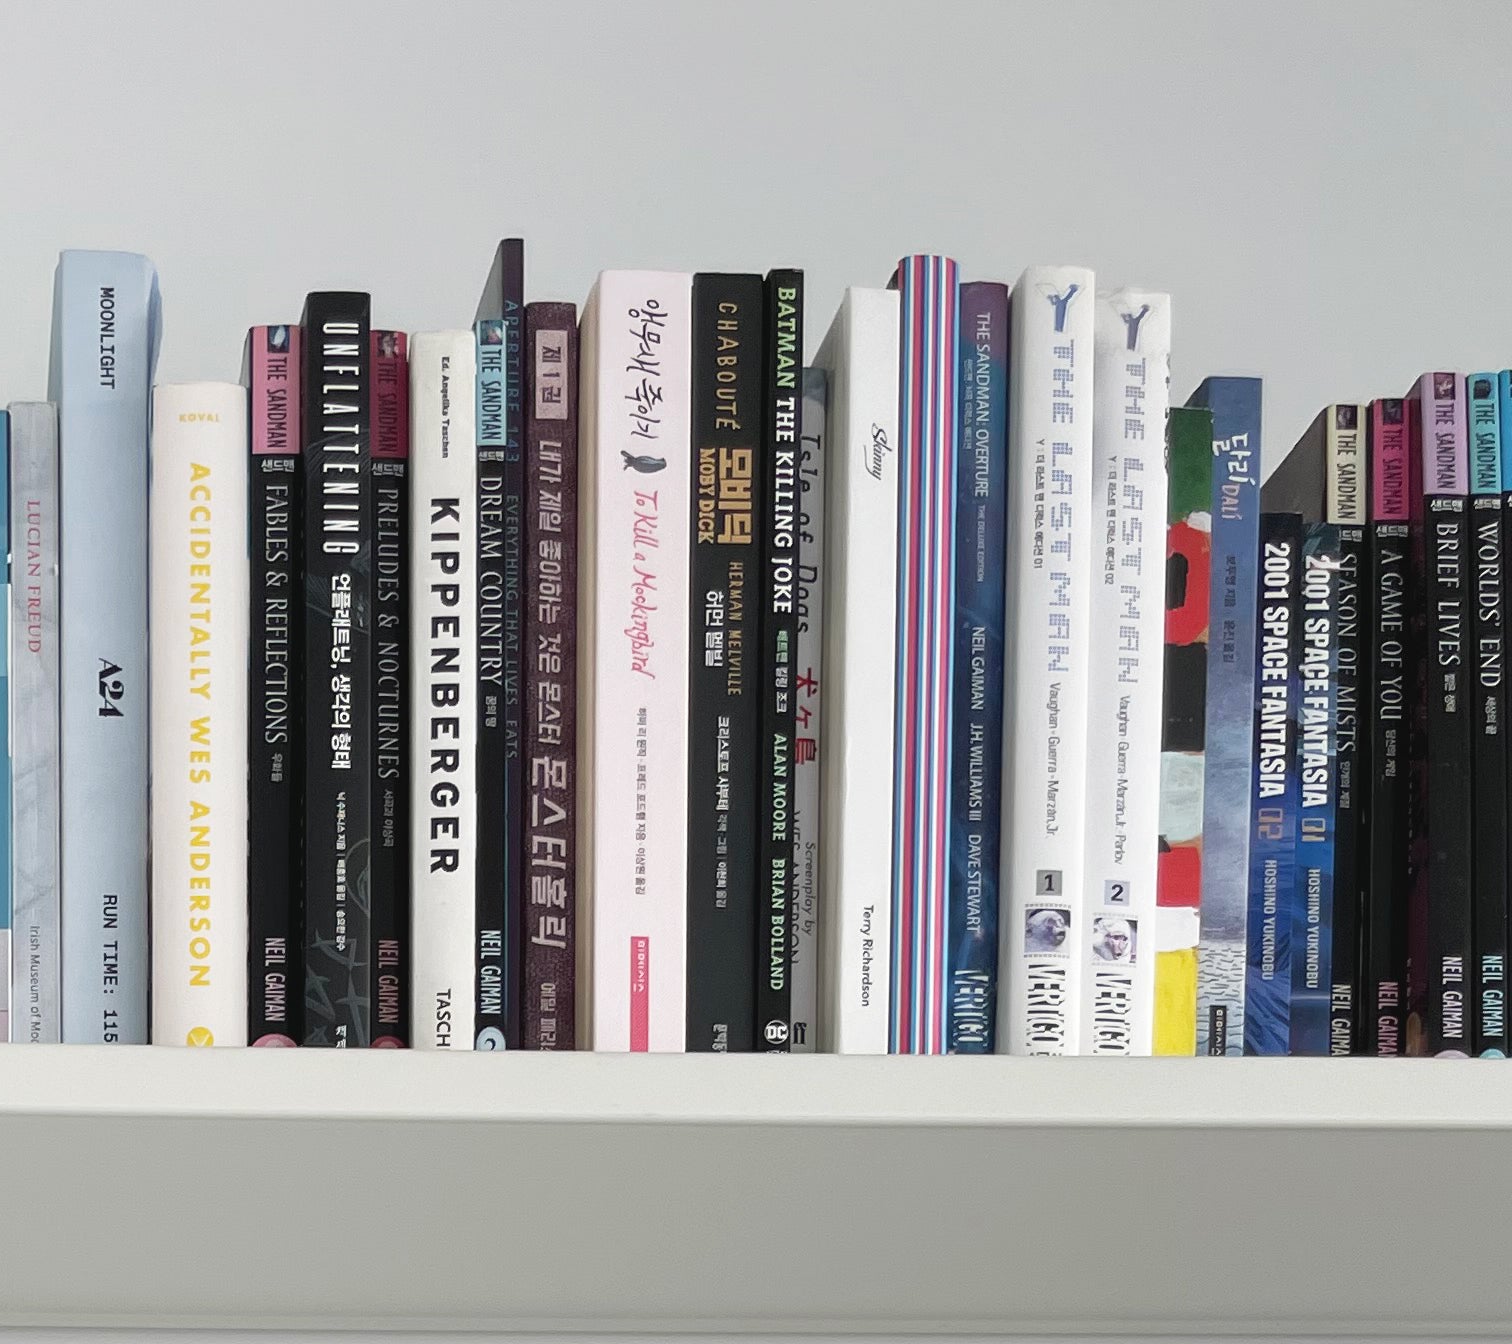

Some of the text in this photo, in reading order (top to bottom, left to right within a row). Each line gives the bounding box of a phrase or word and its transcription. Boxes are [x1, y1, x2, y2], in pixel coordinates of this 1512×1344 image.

[100, 288, 115, 389] MOONLIGHT
[267, 357, 287, 449] THE SANDMAN
[625, 300, 668, 439] 앵무새 죽이기
[716, 303, 740, 430] CHABOUTÉ
[323, 323, 359, 553] UNFLATTENING
[698, 448, 715, 543] MOBY DICK
[717, 448, 752, 544] 모비딕
[772, 288, 796, 613] BATMAN THE KILLING JOKE
[864, 423, 892, 480] Skinny
[27, 501, 41, 652] LUCIAN FREUD
[265, 486, 288, 743] FABLES & REFLECTIONS
[480, 477, 502, 685] DREAM COUNTRY
[624, 491, 658, 679] To Kill a Mockingbird
[1437, 524, 1460, 665] BRIEF LIVES
[1478, 521, 1501, 686] WORLDS' END
[99, 659, 124, 717] A24
[190, 463, 210, 986] ACCIDENTALLY WES ANDERSON
[431, 498, 459, 873] KIPPENBERGER
[104, 895, 118, 1042] RUN TIME: 115
[265, 938, 285, 1021] NEIL GAIMAN
[860, 905, 874, 1006] Terry Richardson
[1260, 860, 1277, 980] HOSHINO YUKINOBU
